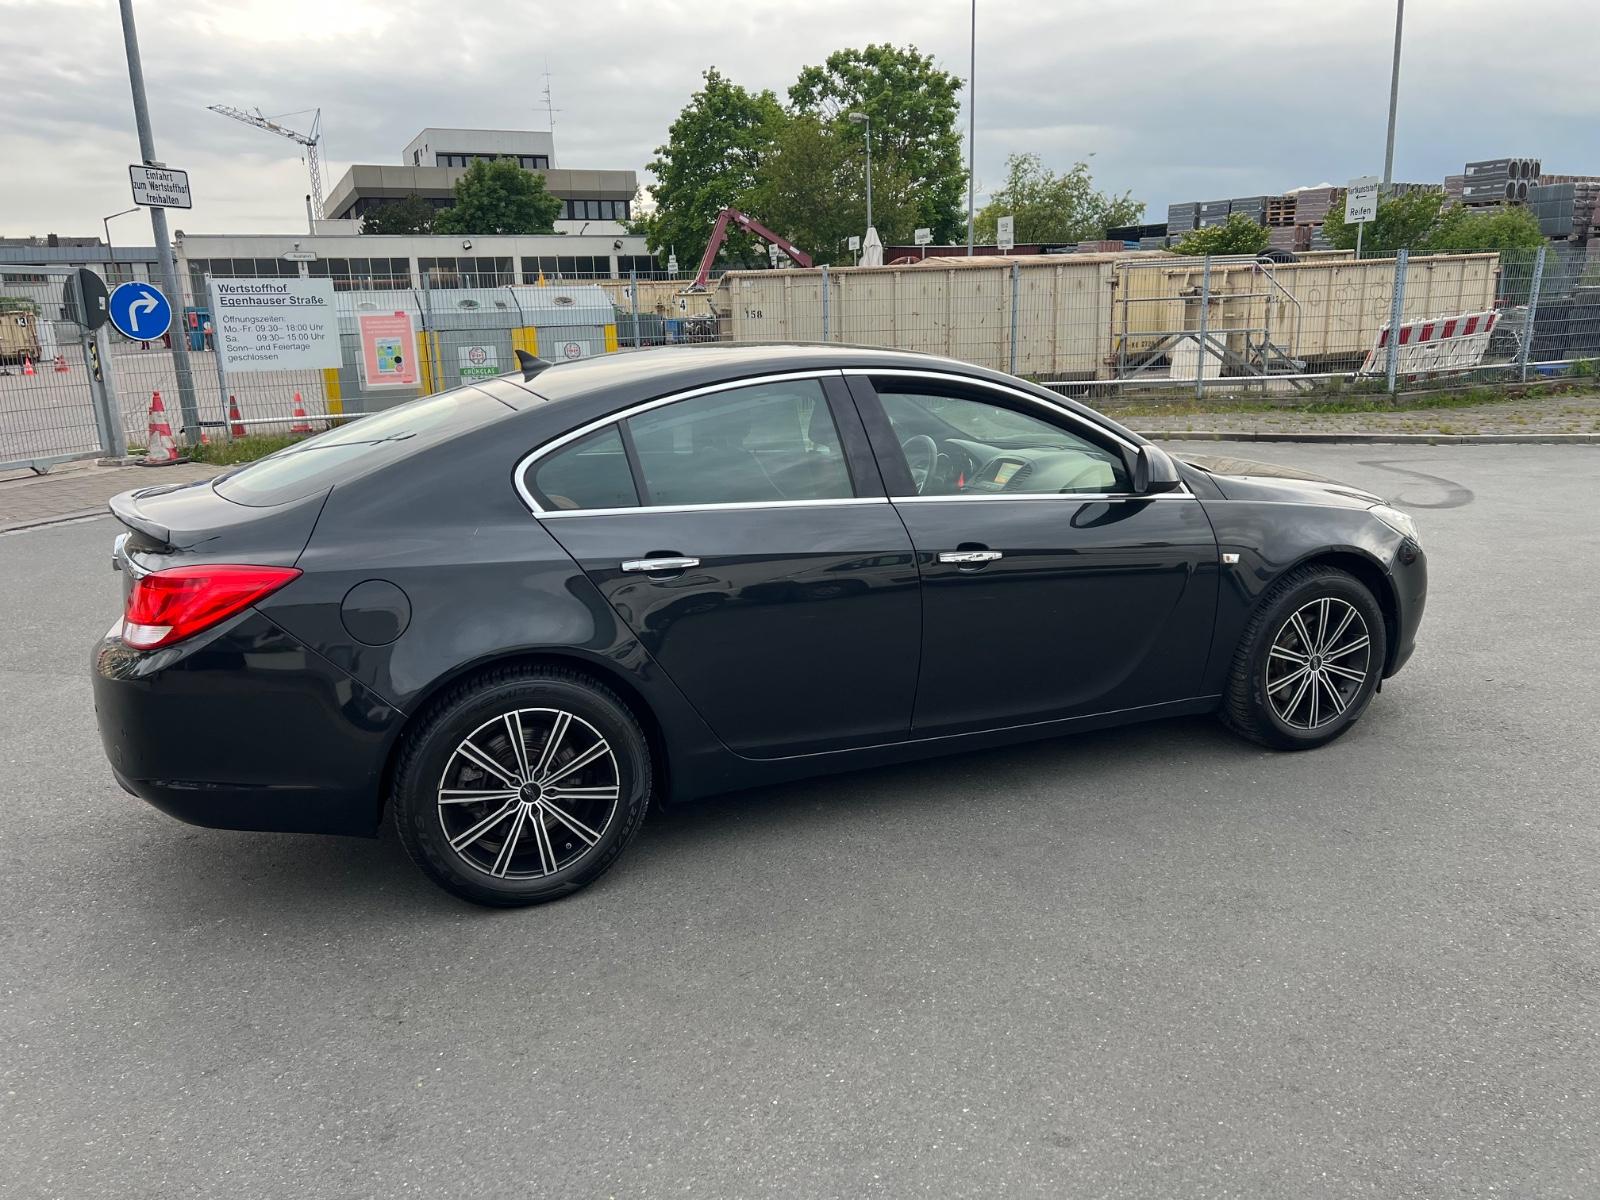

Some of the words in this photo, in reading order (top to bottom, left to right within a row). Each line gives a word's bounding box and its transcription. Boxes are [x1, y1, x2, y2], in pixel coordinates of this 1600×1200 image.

[145, 170, 173, 182] Einfahrt
[133, 181, 147, 190] zum
[148, 181, 188, 194] Wertstoffhof
[146, 193, 180, 205] freihalten
[1350, 206, 1372, 217] Reifen
[217, 283, 288, 293] Wertstoffhof
[220, 296, 287, 307] Egenhauser
[289, 295, 324, 305] Straße
[309, 323, 324, 331] Uhr
[310, 332, 325, 341] Uhr
[255, 343, 271, 352] und
[272, 343, 311, 352] Feiertage
[227, 353, 279, 363] geschlossen
